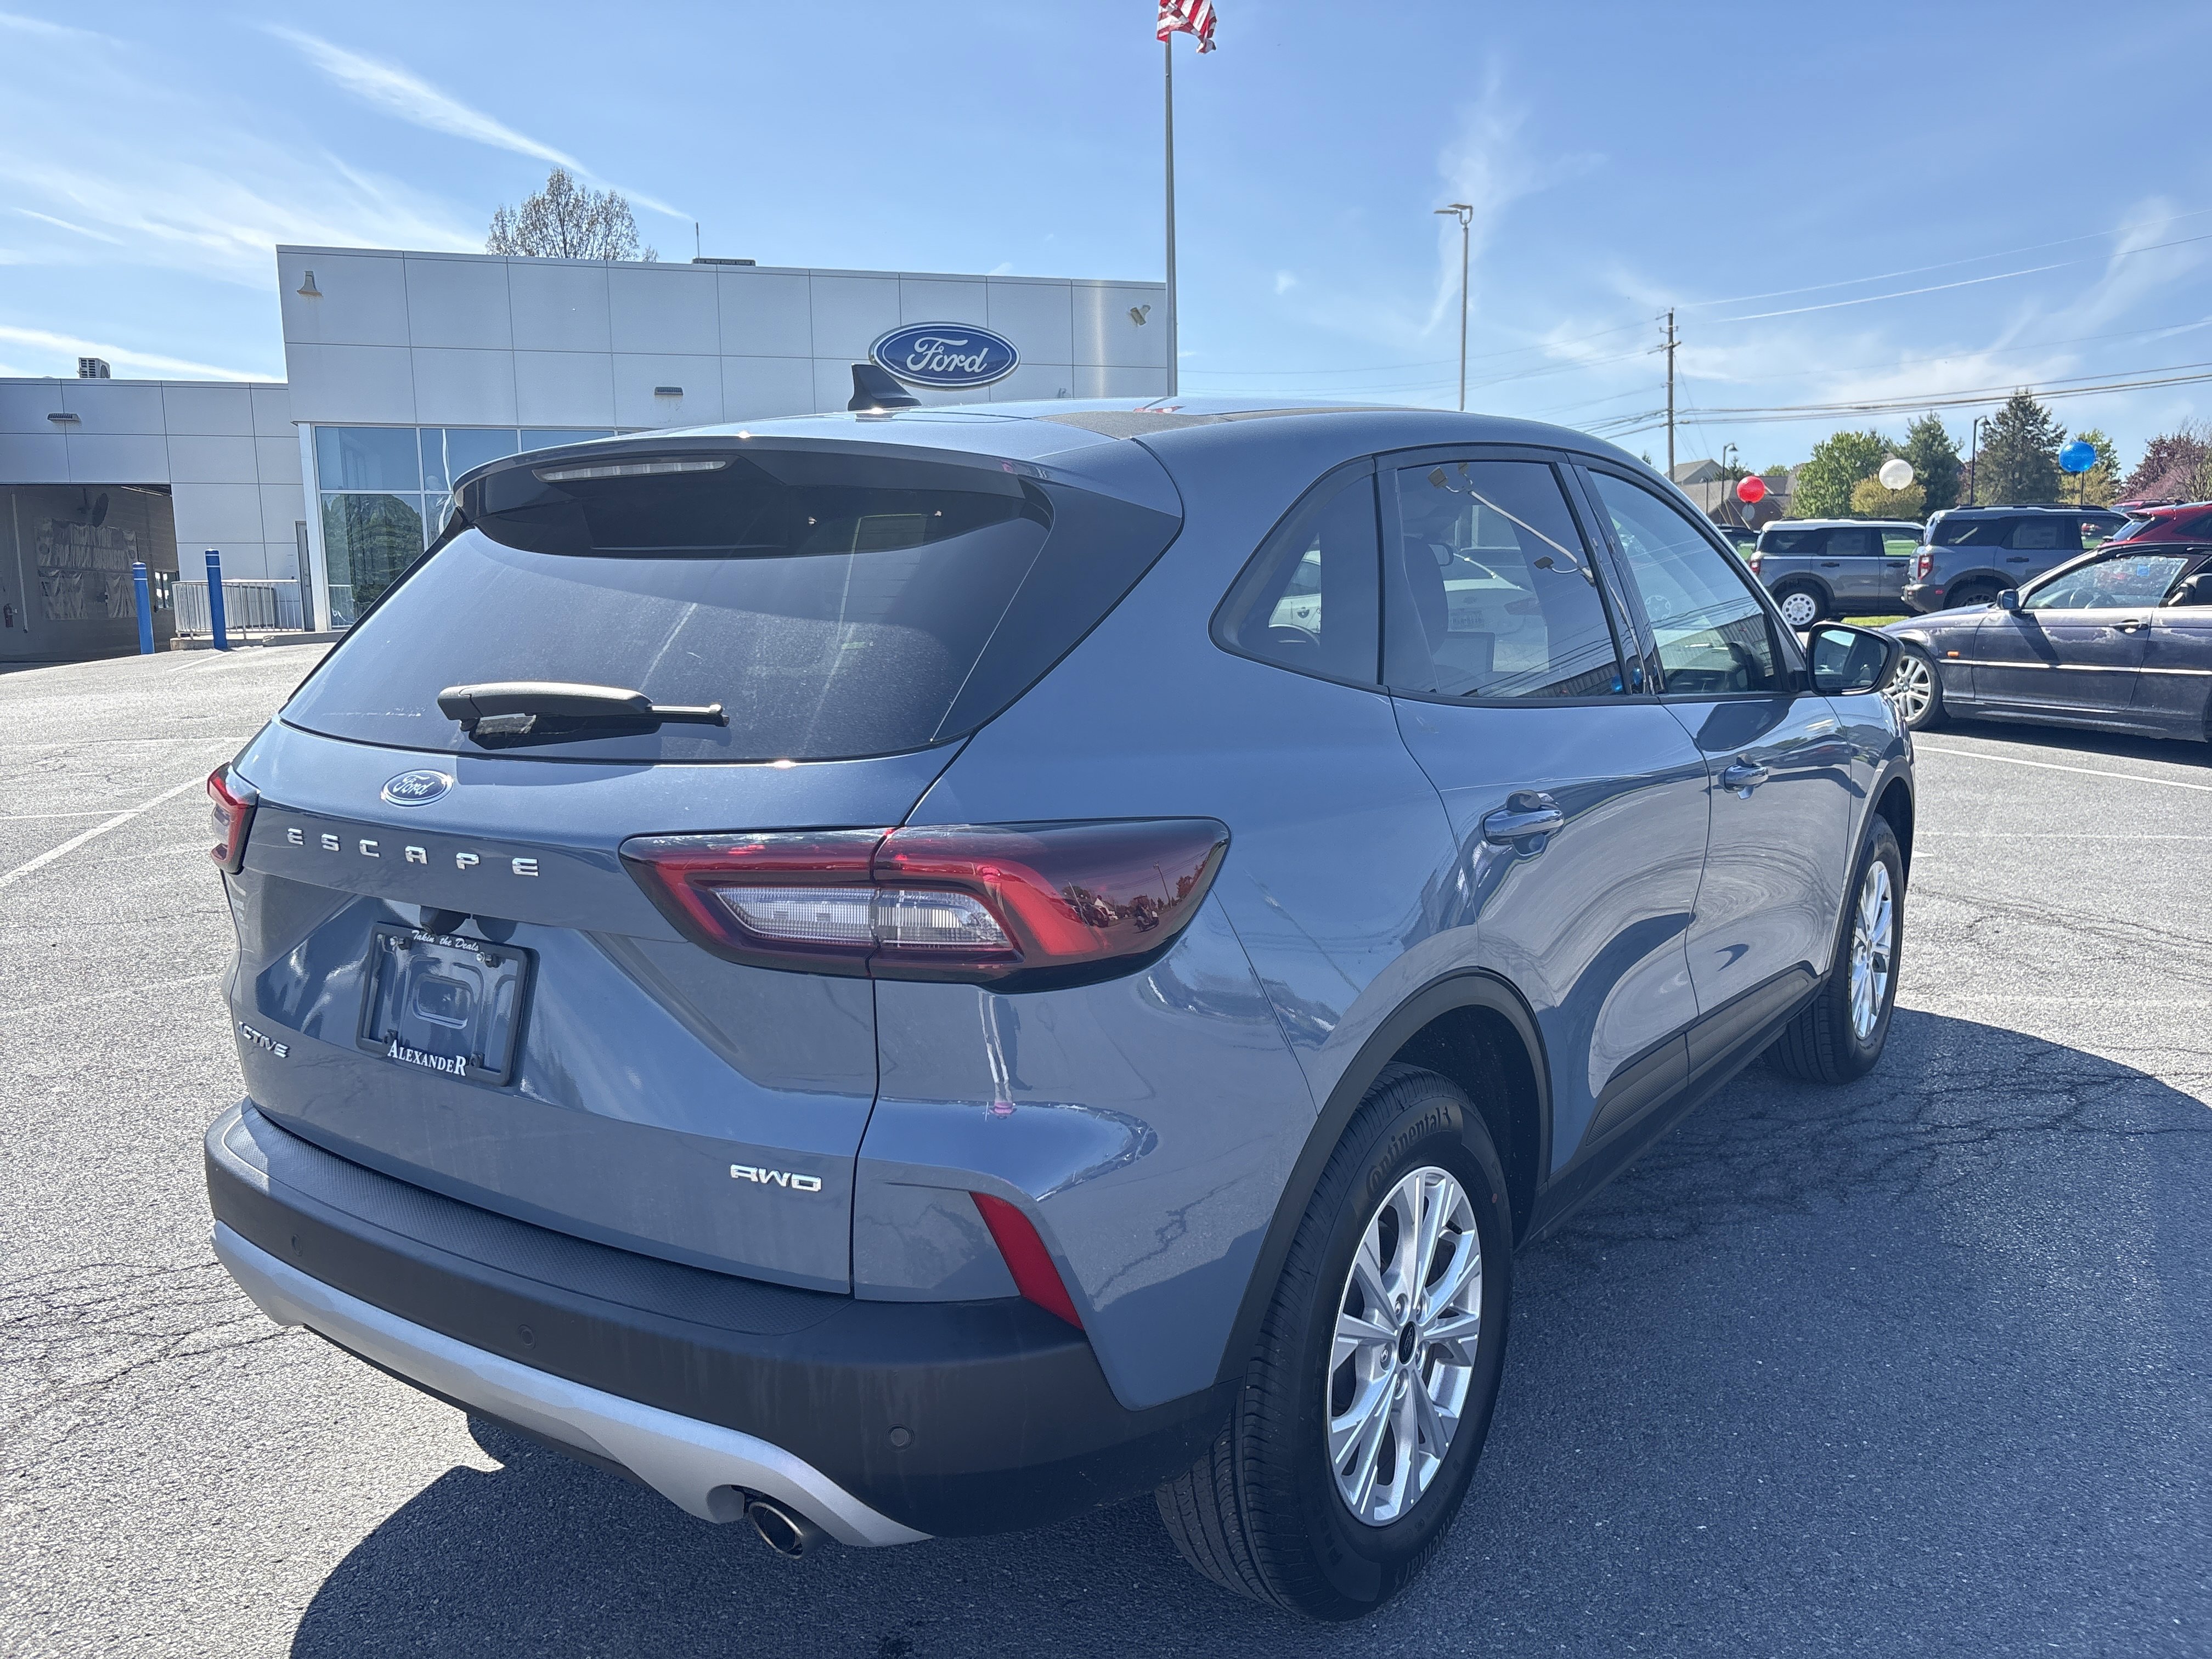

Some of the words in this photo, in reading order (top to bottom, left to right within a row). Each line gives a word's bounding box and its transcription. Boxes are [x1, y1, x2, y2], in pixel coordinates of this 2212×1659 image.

[906, 336, 989, 373] Ford
[392, 775, 435, 795] Ford
[287, 828, 539, 877] ESCAPE
[411, 929, 435, 943] Takin
[439, 936, 453, 946] the
[455, 938, 479, 951] Deals
[387, 1039, 467, 1076] ALEXANDER
[1366, 1107, 1441, 1198] Continental
[730, 1164, 822, 1192] AWD
